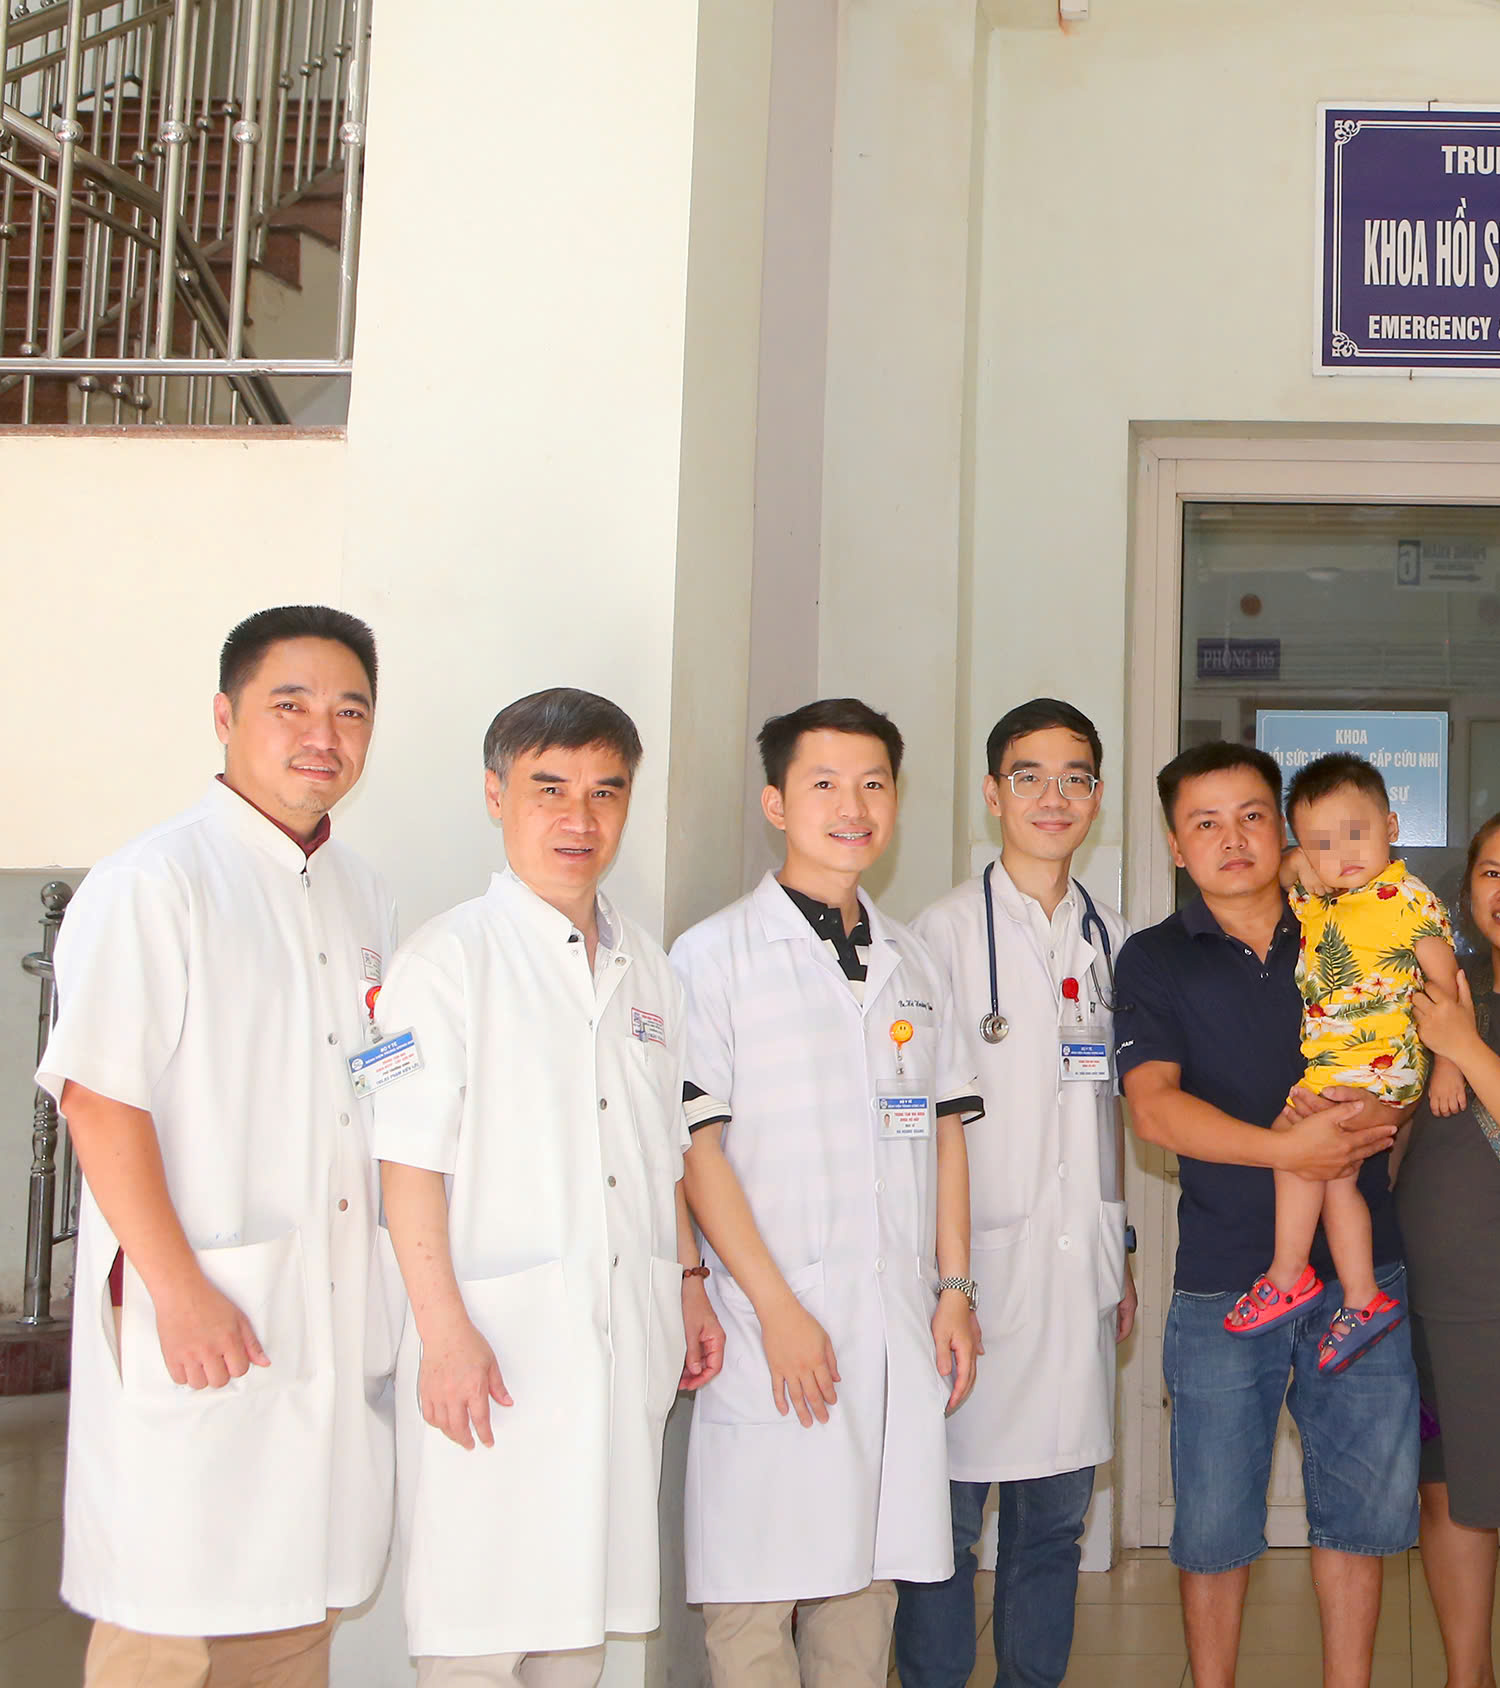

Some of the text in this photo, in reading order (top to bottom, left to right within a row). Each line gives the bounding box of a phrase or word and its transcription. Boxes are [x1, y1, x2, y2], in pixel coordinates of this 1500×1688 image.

[1364, 219, 1429, 287] KHOA
[1435, 197, 1476, 288] HỒI
[1368, 315, 1492, 341] EMERGENCY
[1335, 729, 1368, 745] KHOA
[1286, 748, 1309, 767] SỨC
[1369, 747, 1392, 767] CẤP
[1394, 749, 1417, 768] CỨU
[1419, 752, 1439, 768] NHI
[1389, 785, 1411, 805] SỰ
